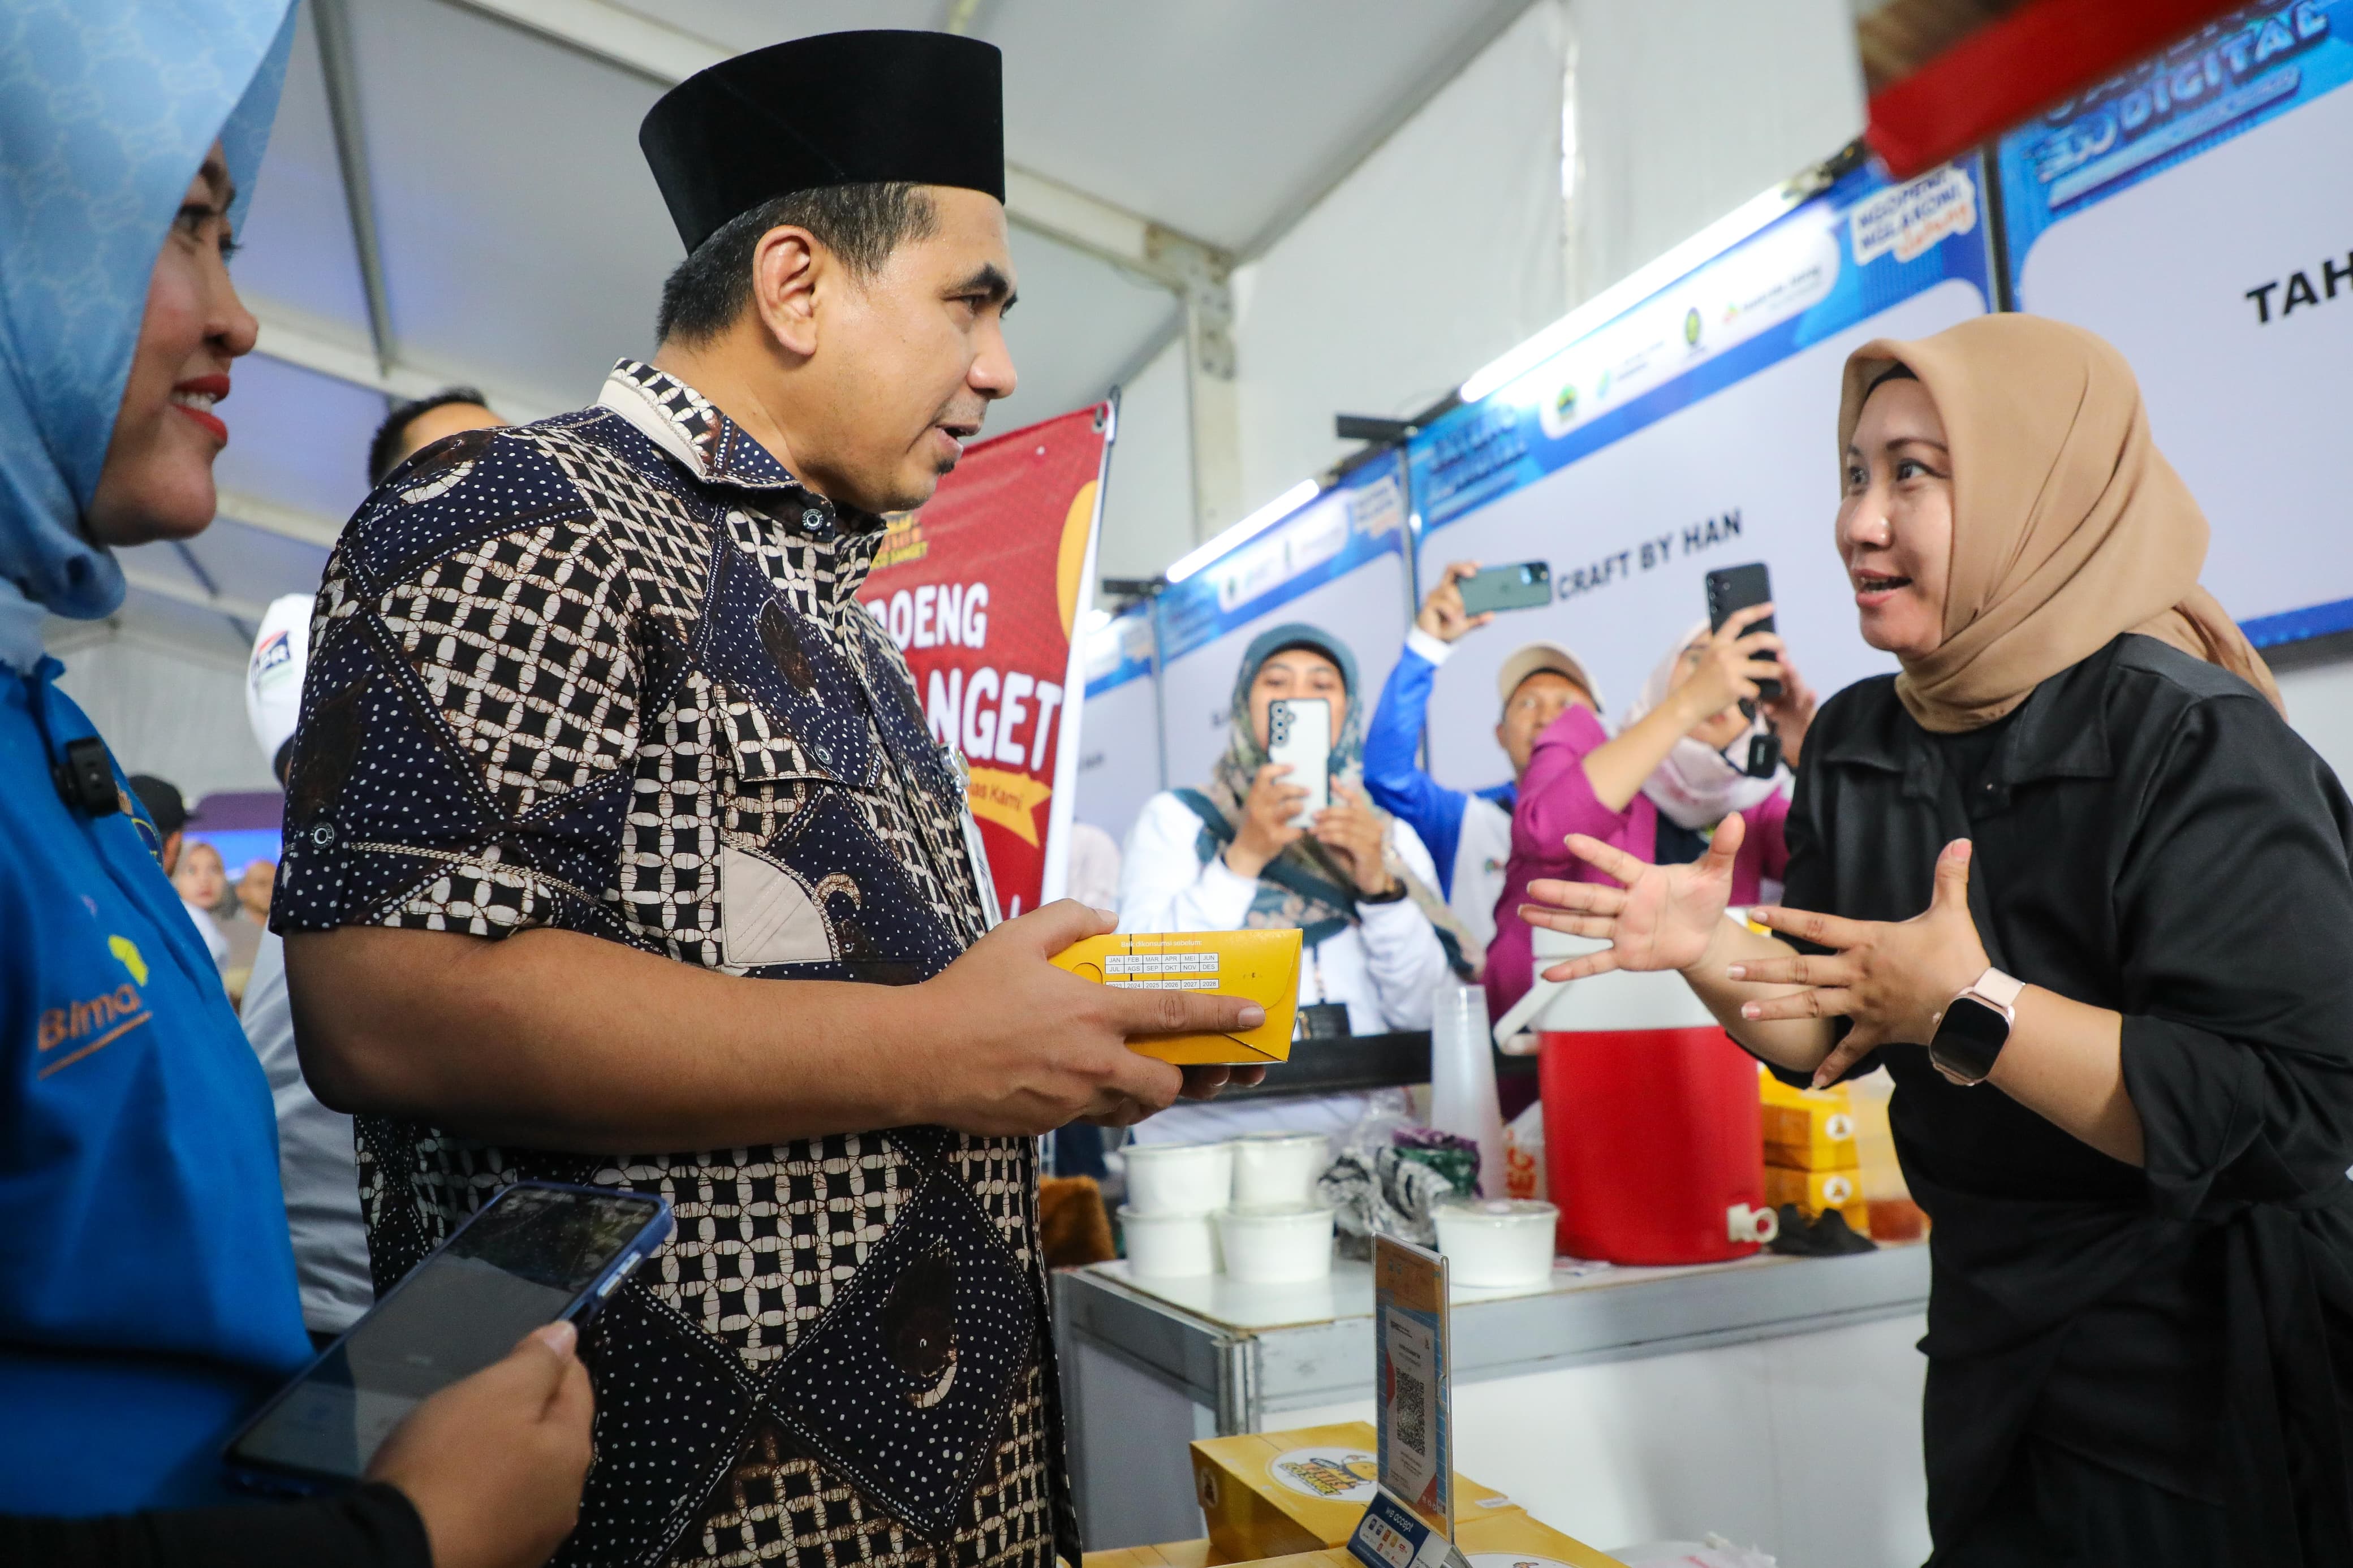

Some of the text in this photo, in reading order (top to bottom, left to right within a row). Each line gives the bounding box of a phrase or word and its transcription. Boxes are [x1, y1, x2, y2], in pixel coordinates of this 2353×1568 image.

[2119, 0, 2328, 130] DIGITAL
[1558, 508, 1742, 601] CRAFT BY HAN
[910, 667, 1063, 772] NGET
[1393, 1513, 1413, 1532] accept
